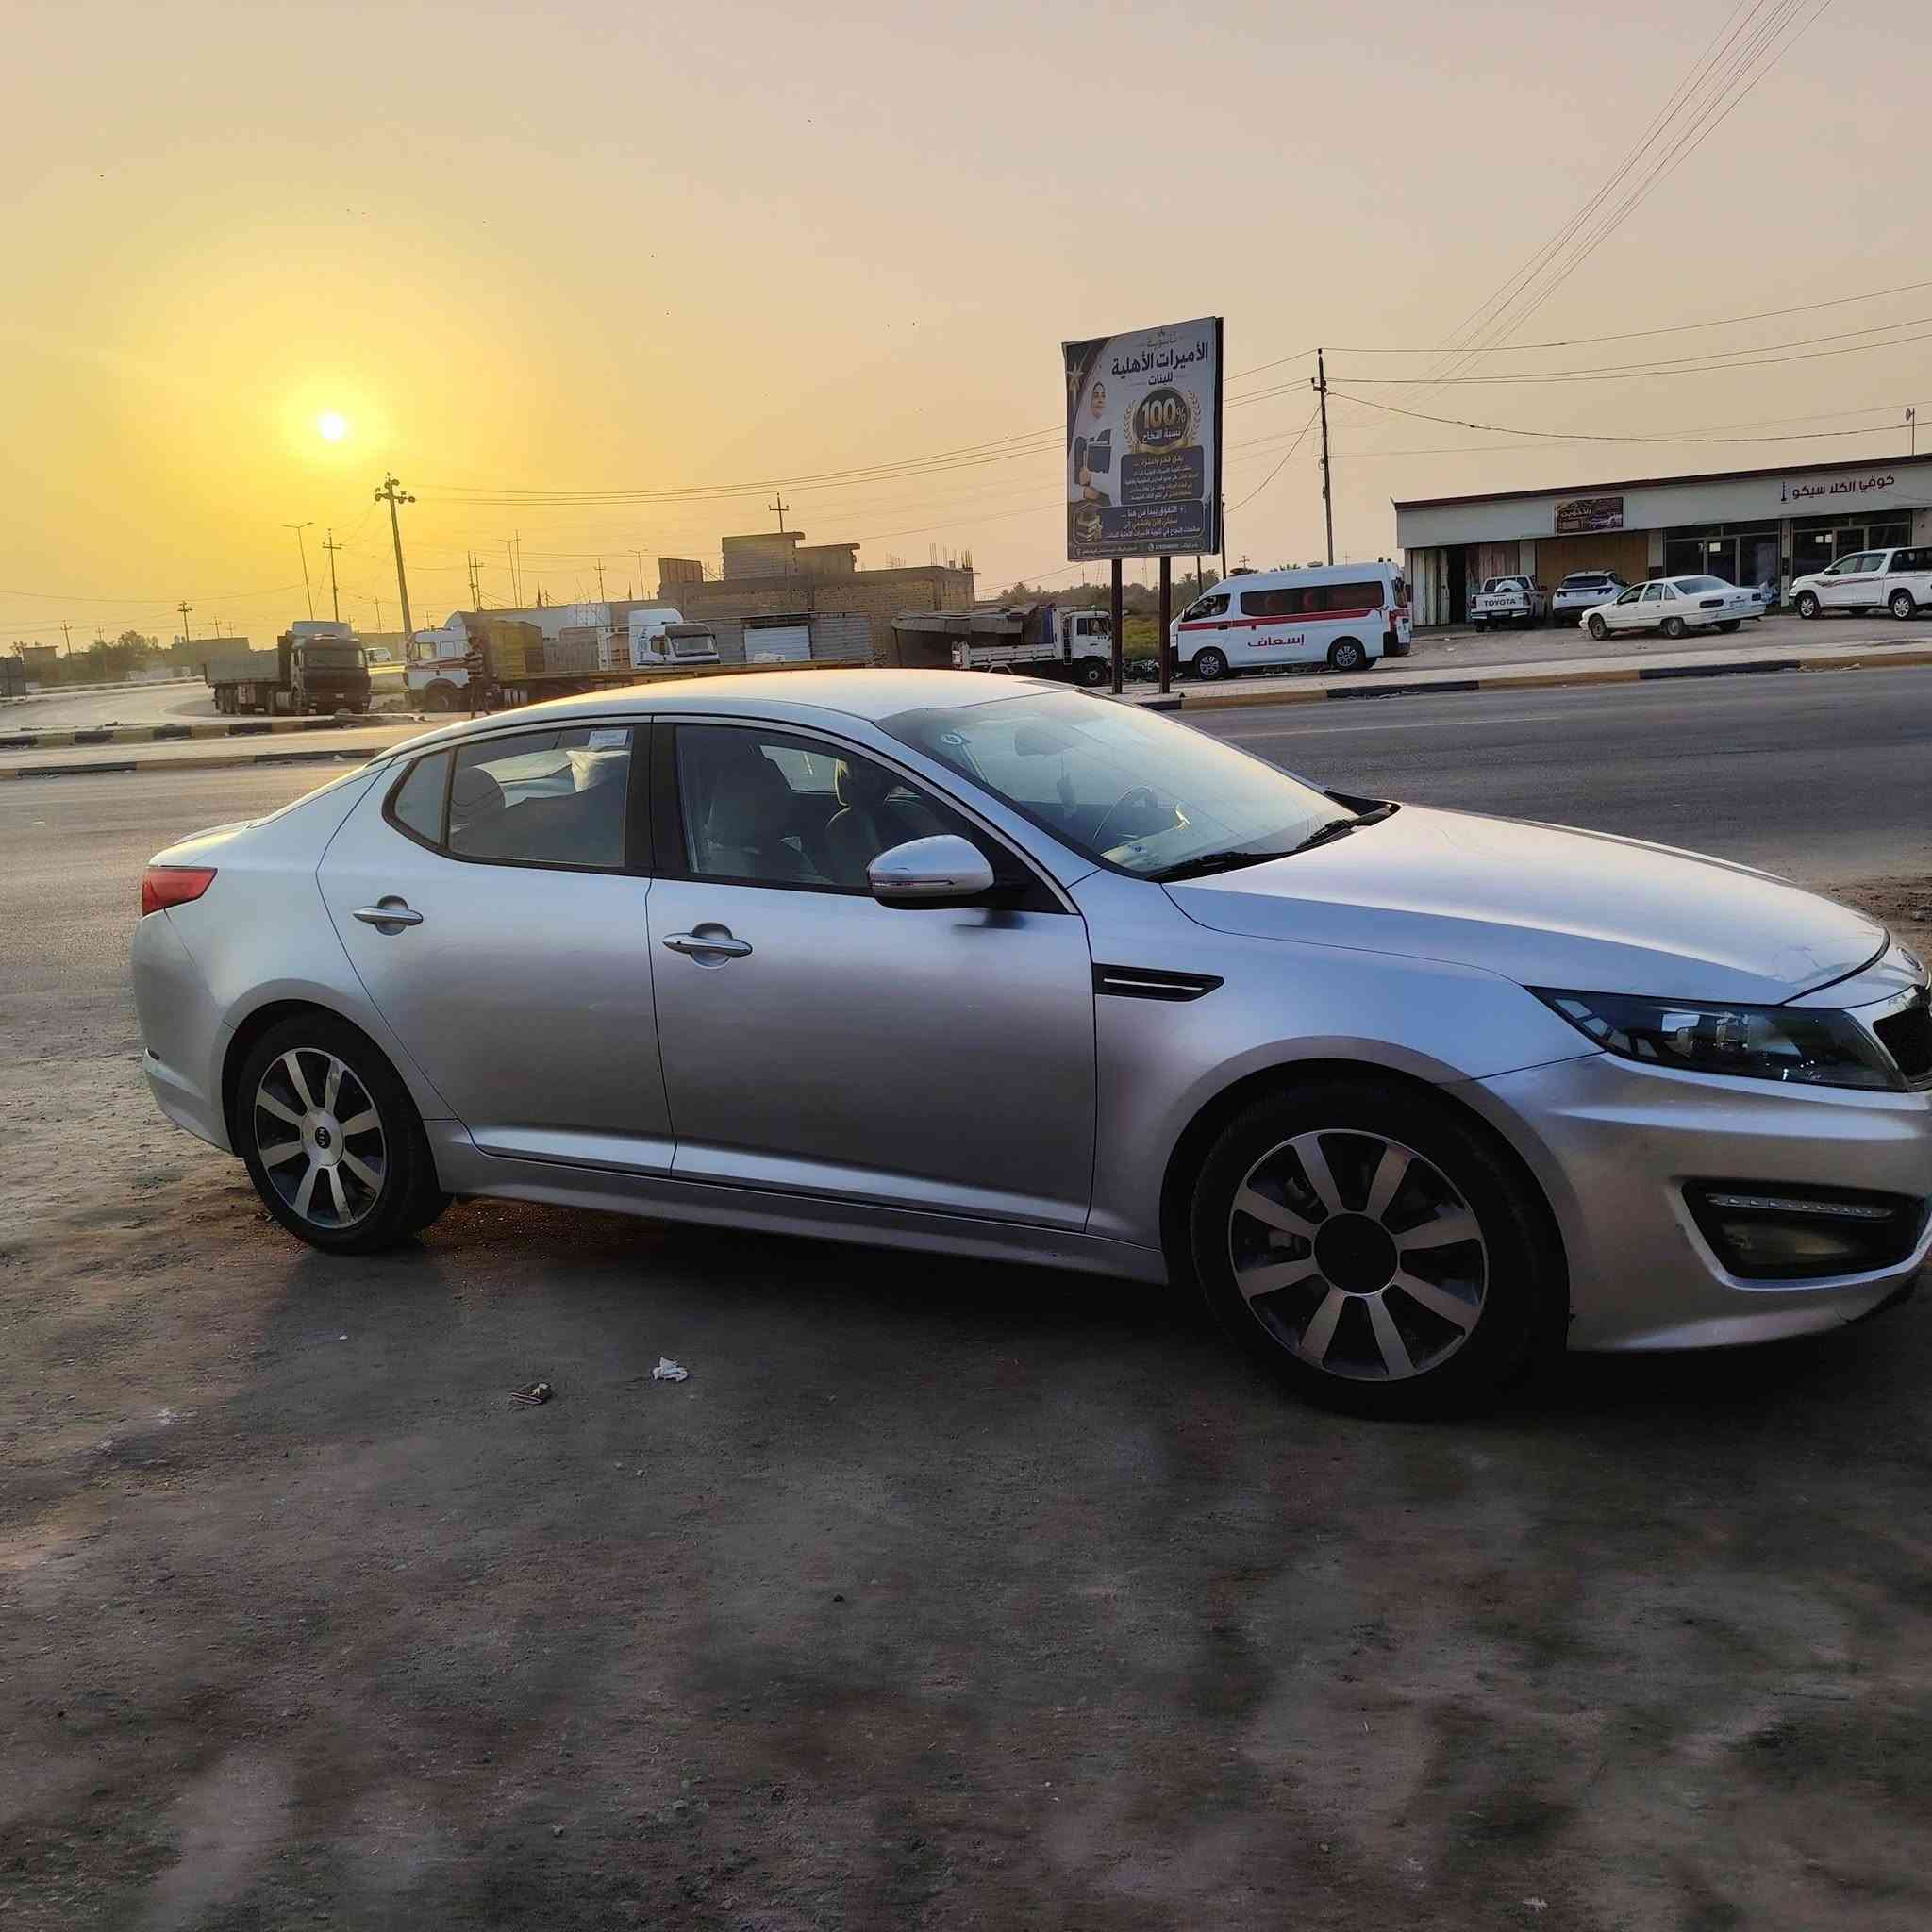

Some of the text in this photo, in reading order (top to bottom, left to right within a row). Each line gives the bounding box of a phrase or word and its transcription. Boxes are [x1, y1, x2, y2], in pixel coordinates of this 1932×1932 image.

[1111, 341, 1208, 380] الأميرات الأهلية
[1148, 372, 1173, 385] للبنات
[1141, 397, 1185, 428] 100%
[1858, 475, 1895, 492] كوفي
[1484, 598, 1516, 607] TOYOTA
[1247, 633, 1305, 647] إسعاف
